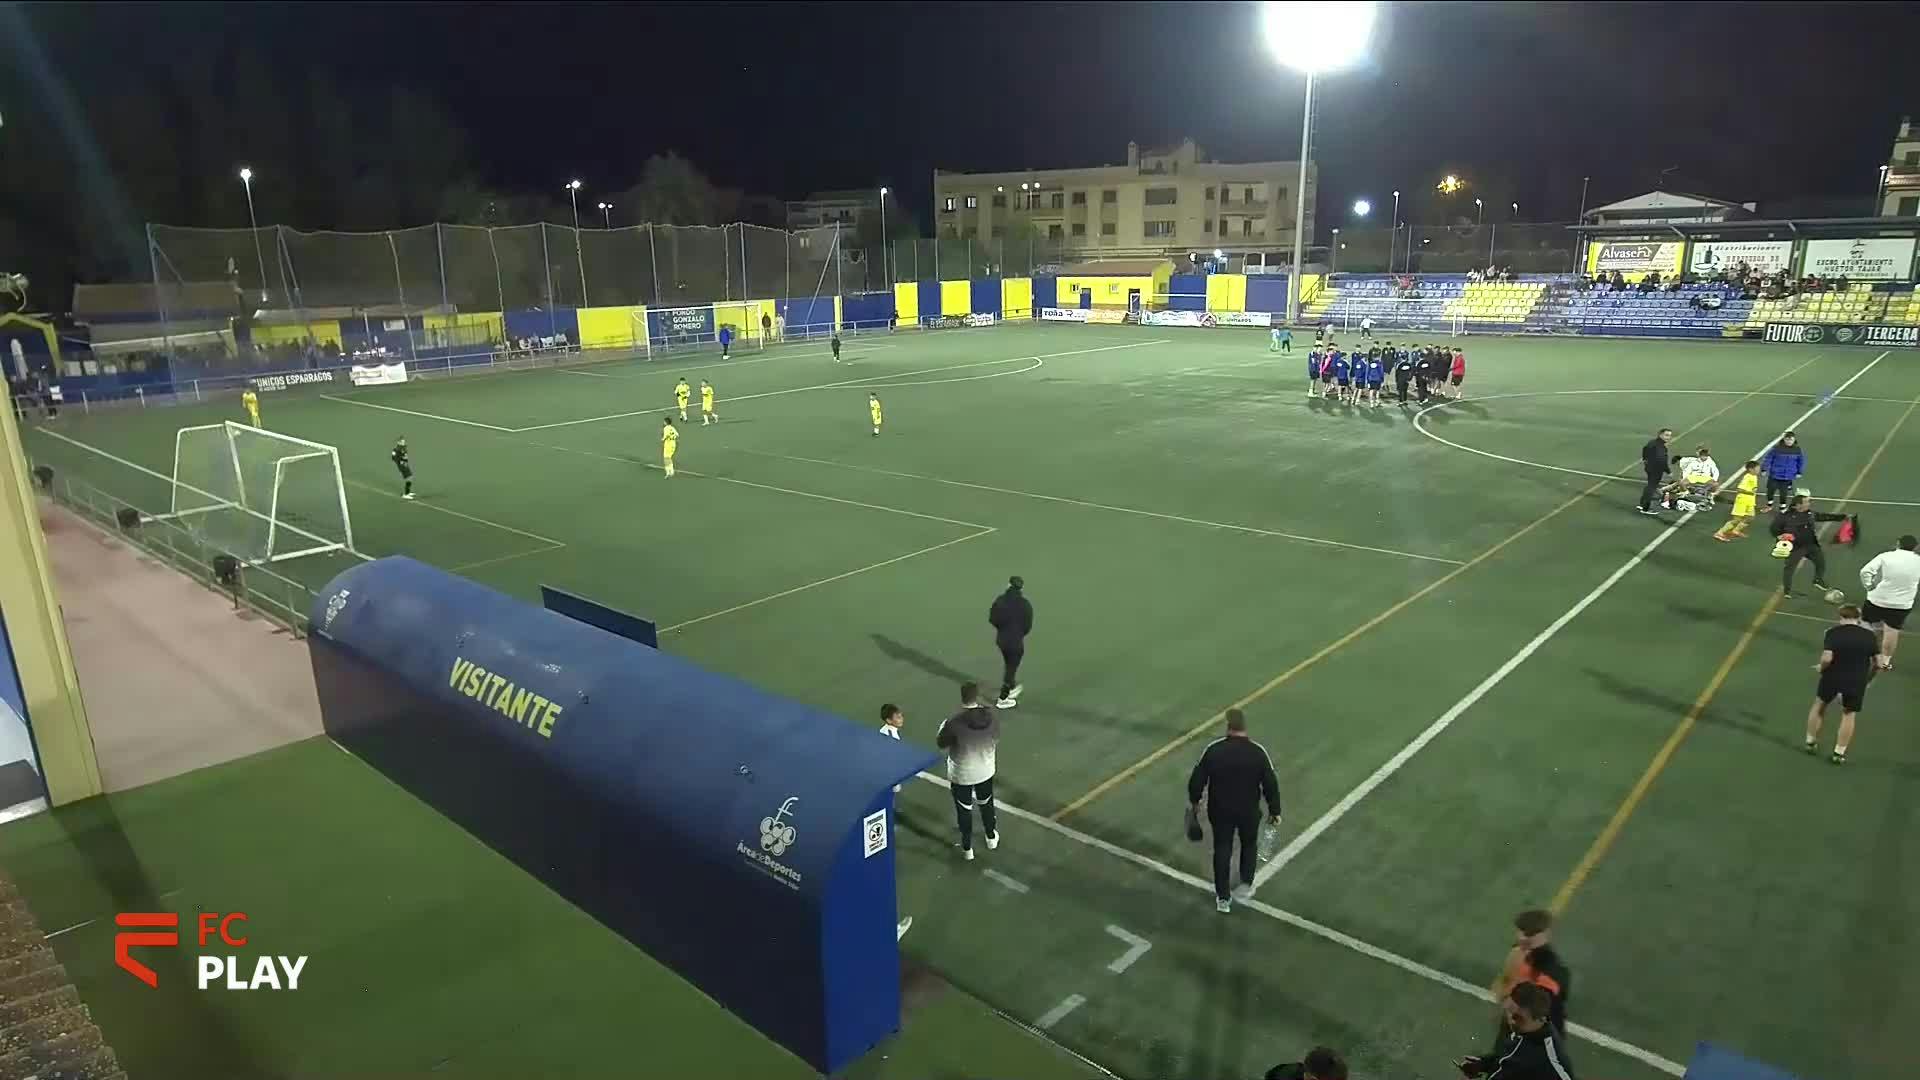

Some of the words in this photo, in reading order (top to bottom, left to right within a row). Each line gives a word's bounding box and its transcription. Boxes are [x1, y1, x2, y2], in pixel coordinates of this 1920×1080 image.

[672, 315, 705, 323] GONZALO
[1867, 326, 1919, 341] TERCERA
[450, 656, 563, 738] VISITANTE
